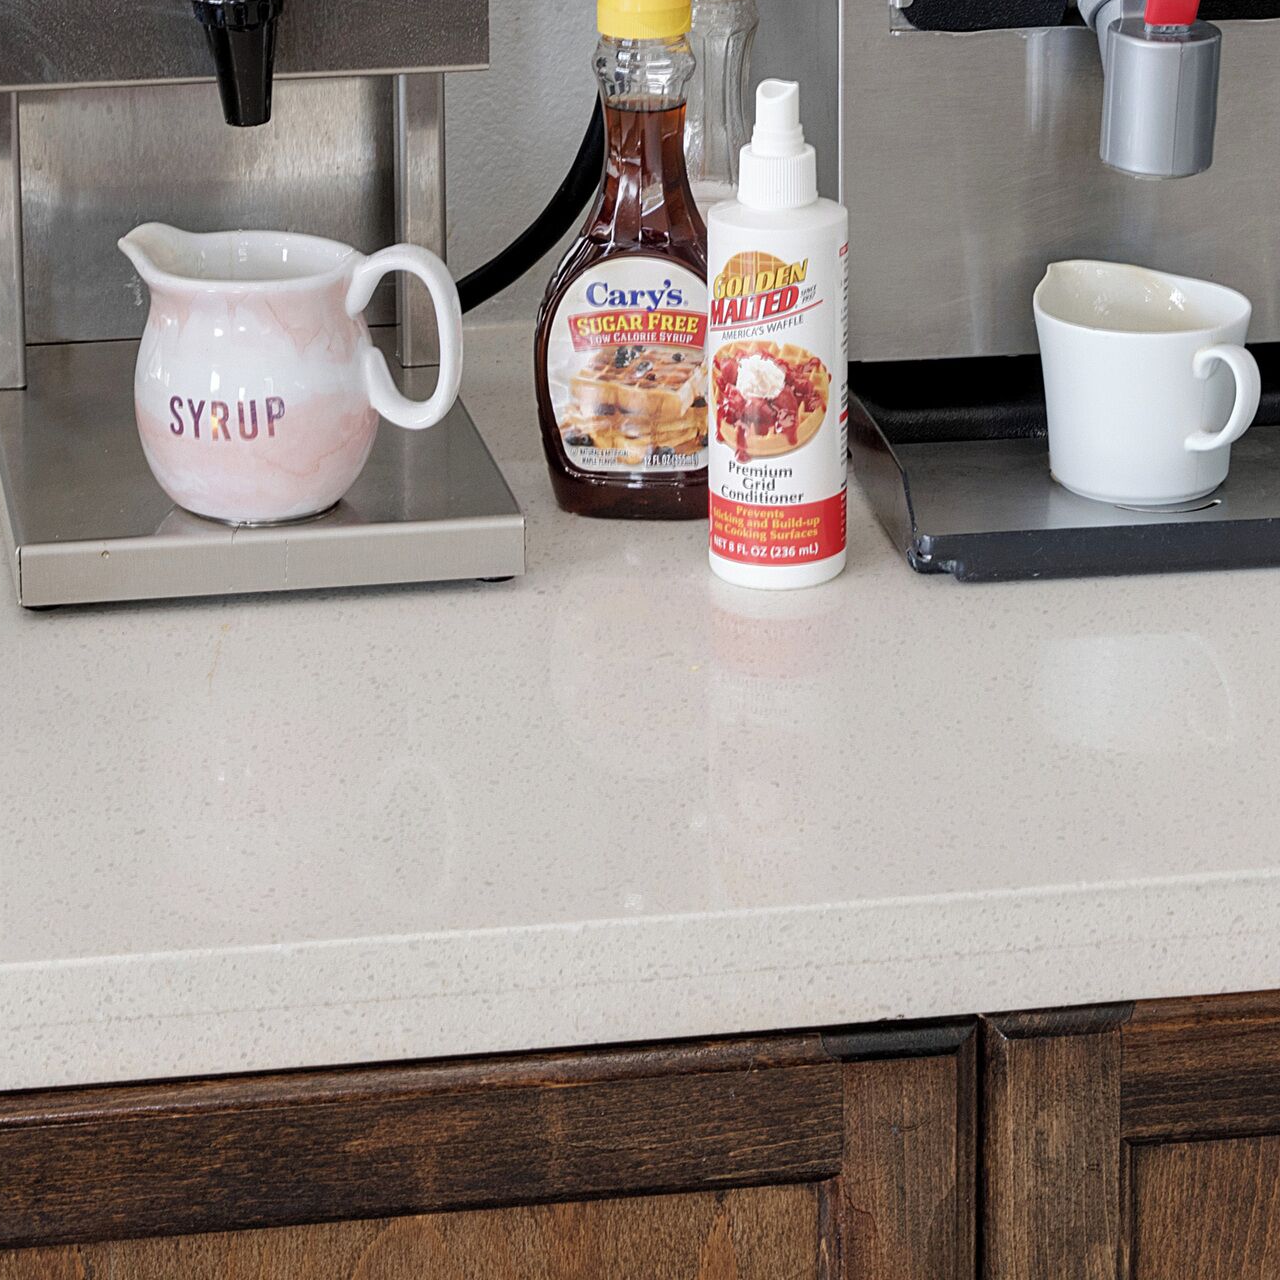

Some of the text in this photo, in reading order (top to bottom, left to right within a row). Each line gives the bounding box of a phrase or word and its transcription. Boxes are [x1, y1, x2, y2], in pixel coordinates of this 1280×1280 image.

[713, 258, 809, 300] GOLDEN
[585, 279, 683, 312] Cary's
[710, 285, 799, 327] MALTED
[577, 312, 699, 336] SUGAR FREE
[721, 314, 804, 341] AMERICA'S WAFFLE
[590, 331, 693, 345] LOW CALORIE SYRUP
[168, 395, 286, 442] SYRUP
[728, 460, 793, 478] Premium
[742, 477, 776, 491] Grid
[721, 484, 804, 504] Conditioner
[736, 505, 785, 519] Prevents
[747, 518, 768, 528] and
[772, 516, 820, 529] Build-up
[724, 523, 767, 542] Cooking
[770, 528, 818, 540] Surfaces
[728, 540, 734, 552] 8
[736, 542, 748, 555] FL
[750, 545, 767, 557] OZ
[770, 545, 795, 559] (236
[799, 542, 819, 556] mL)
